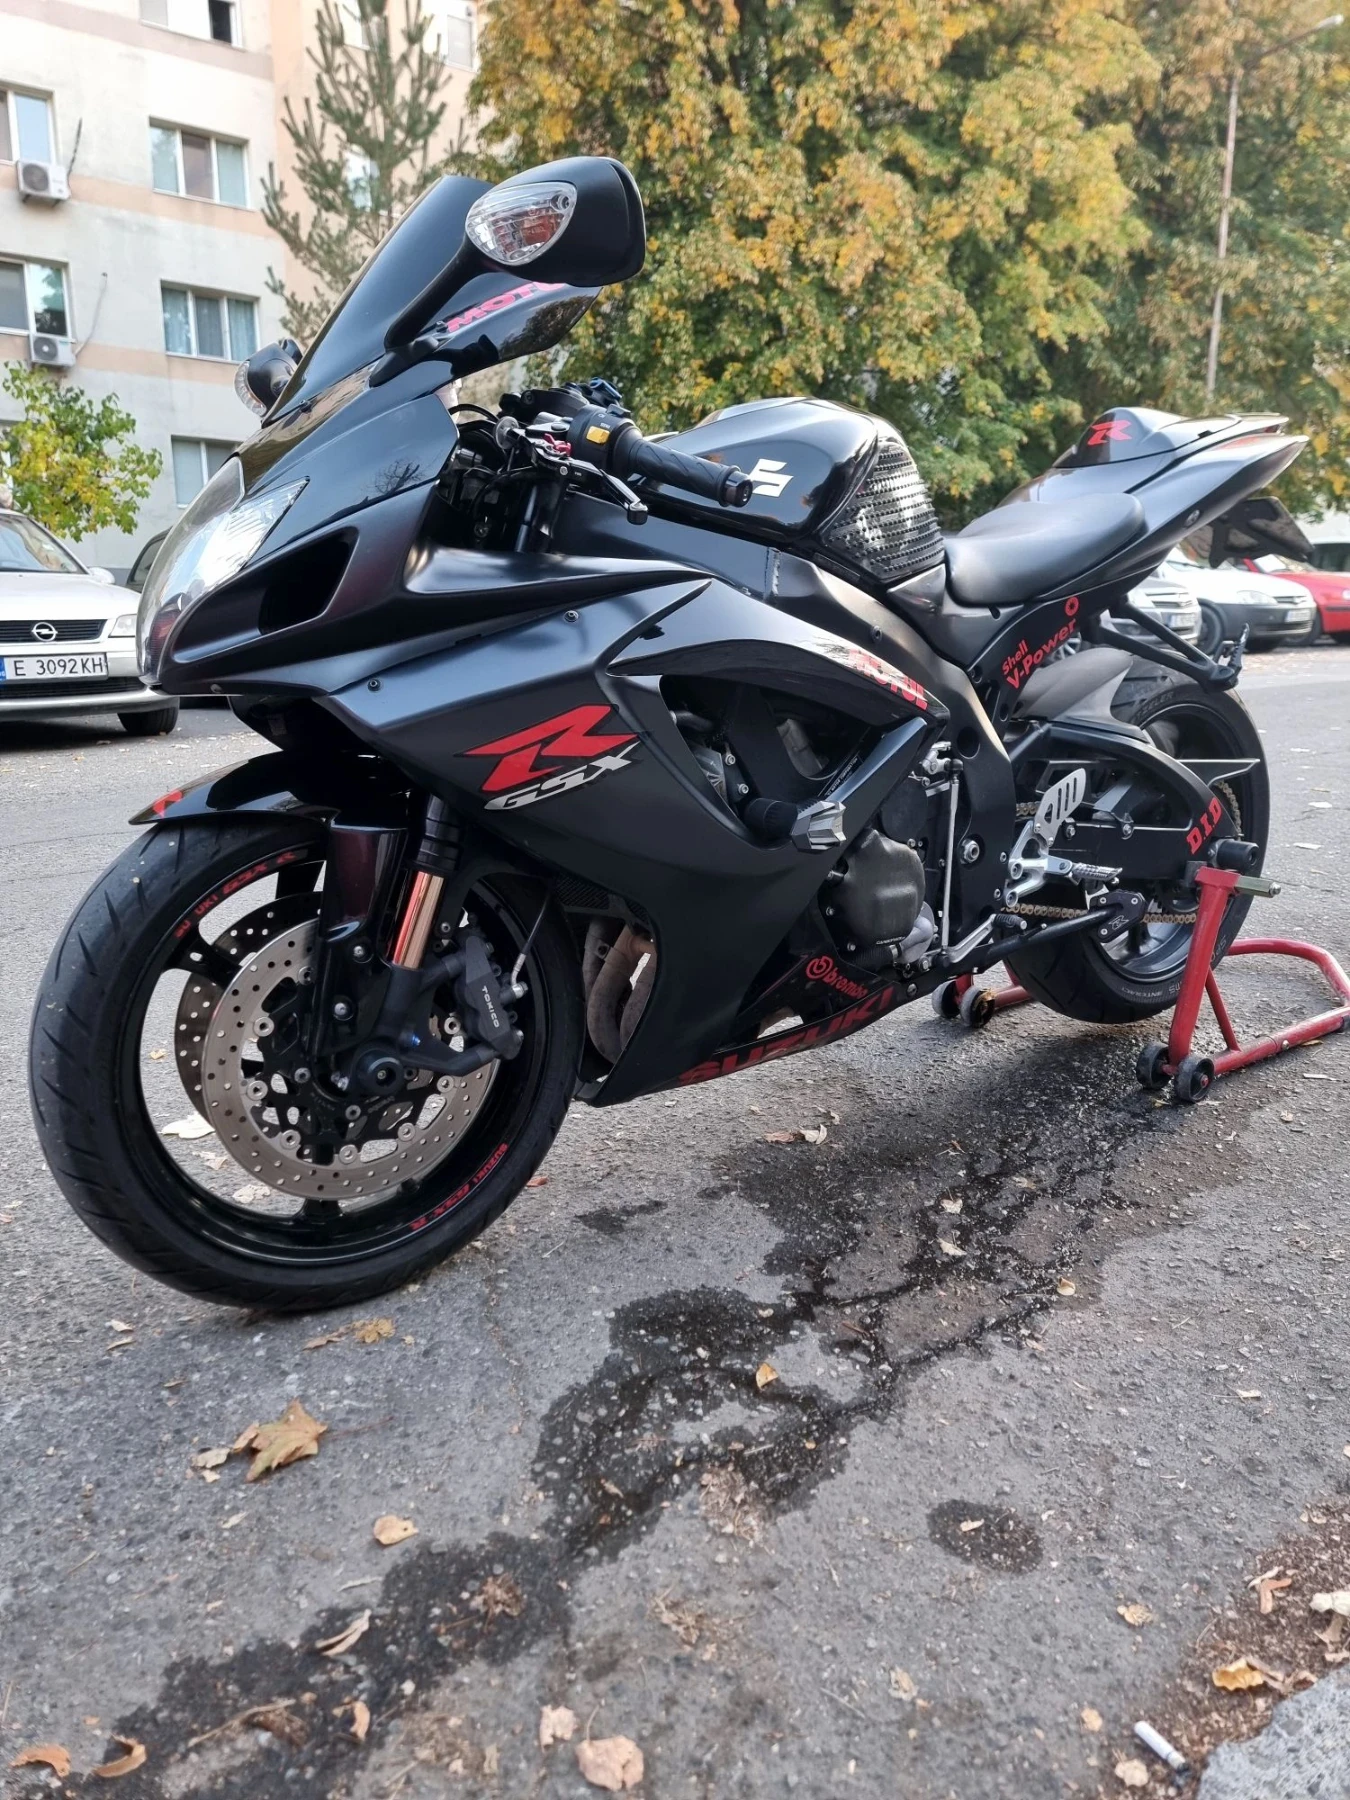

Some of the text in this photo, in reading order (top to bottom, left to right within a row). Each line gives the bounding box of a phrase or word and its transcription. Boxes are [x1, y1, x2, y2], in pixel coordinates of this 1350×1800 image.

[13, 660, 26, 676] E
[1002, 640, 1029, 675] Shell
[1006, 618, 1077, 689] V-Power
[483, 740, 641, 810] GSX
[481, 985, 500, 1028] TOKICO
